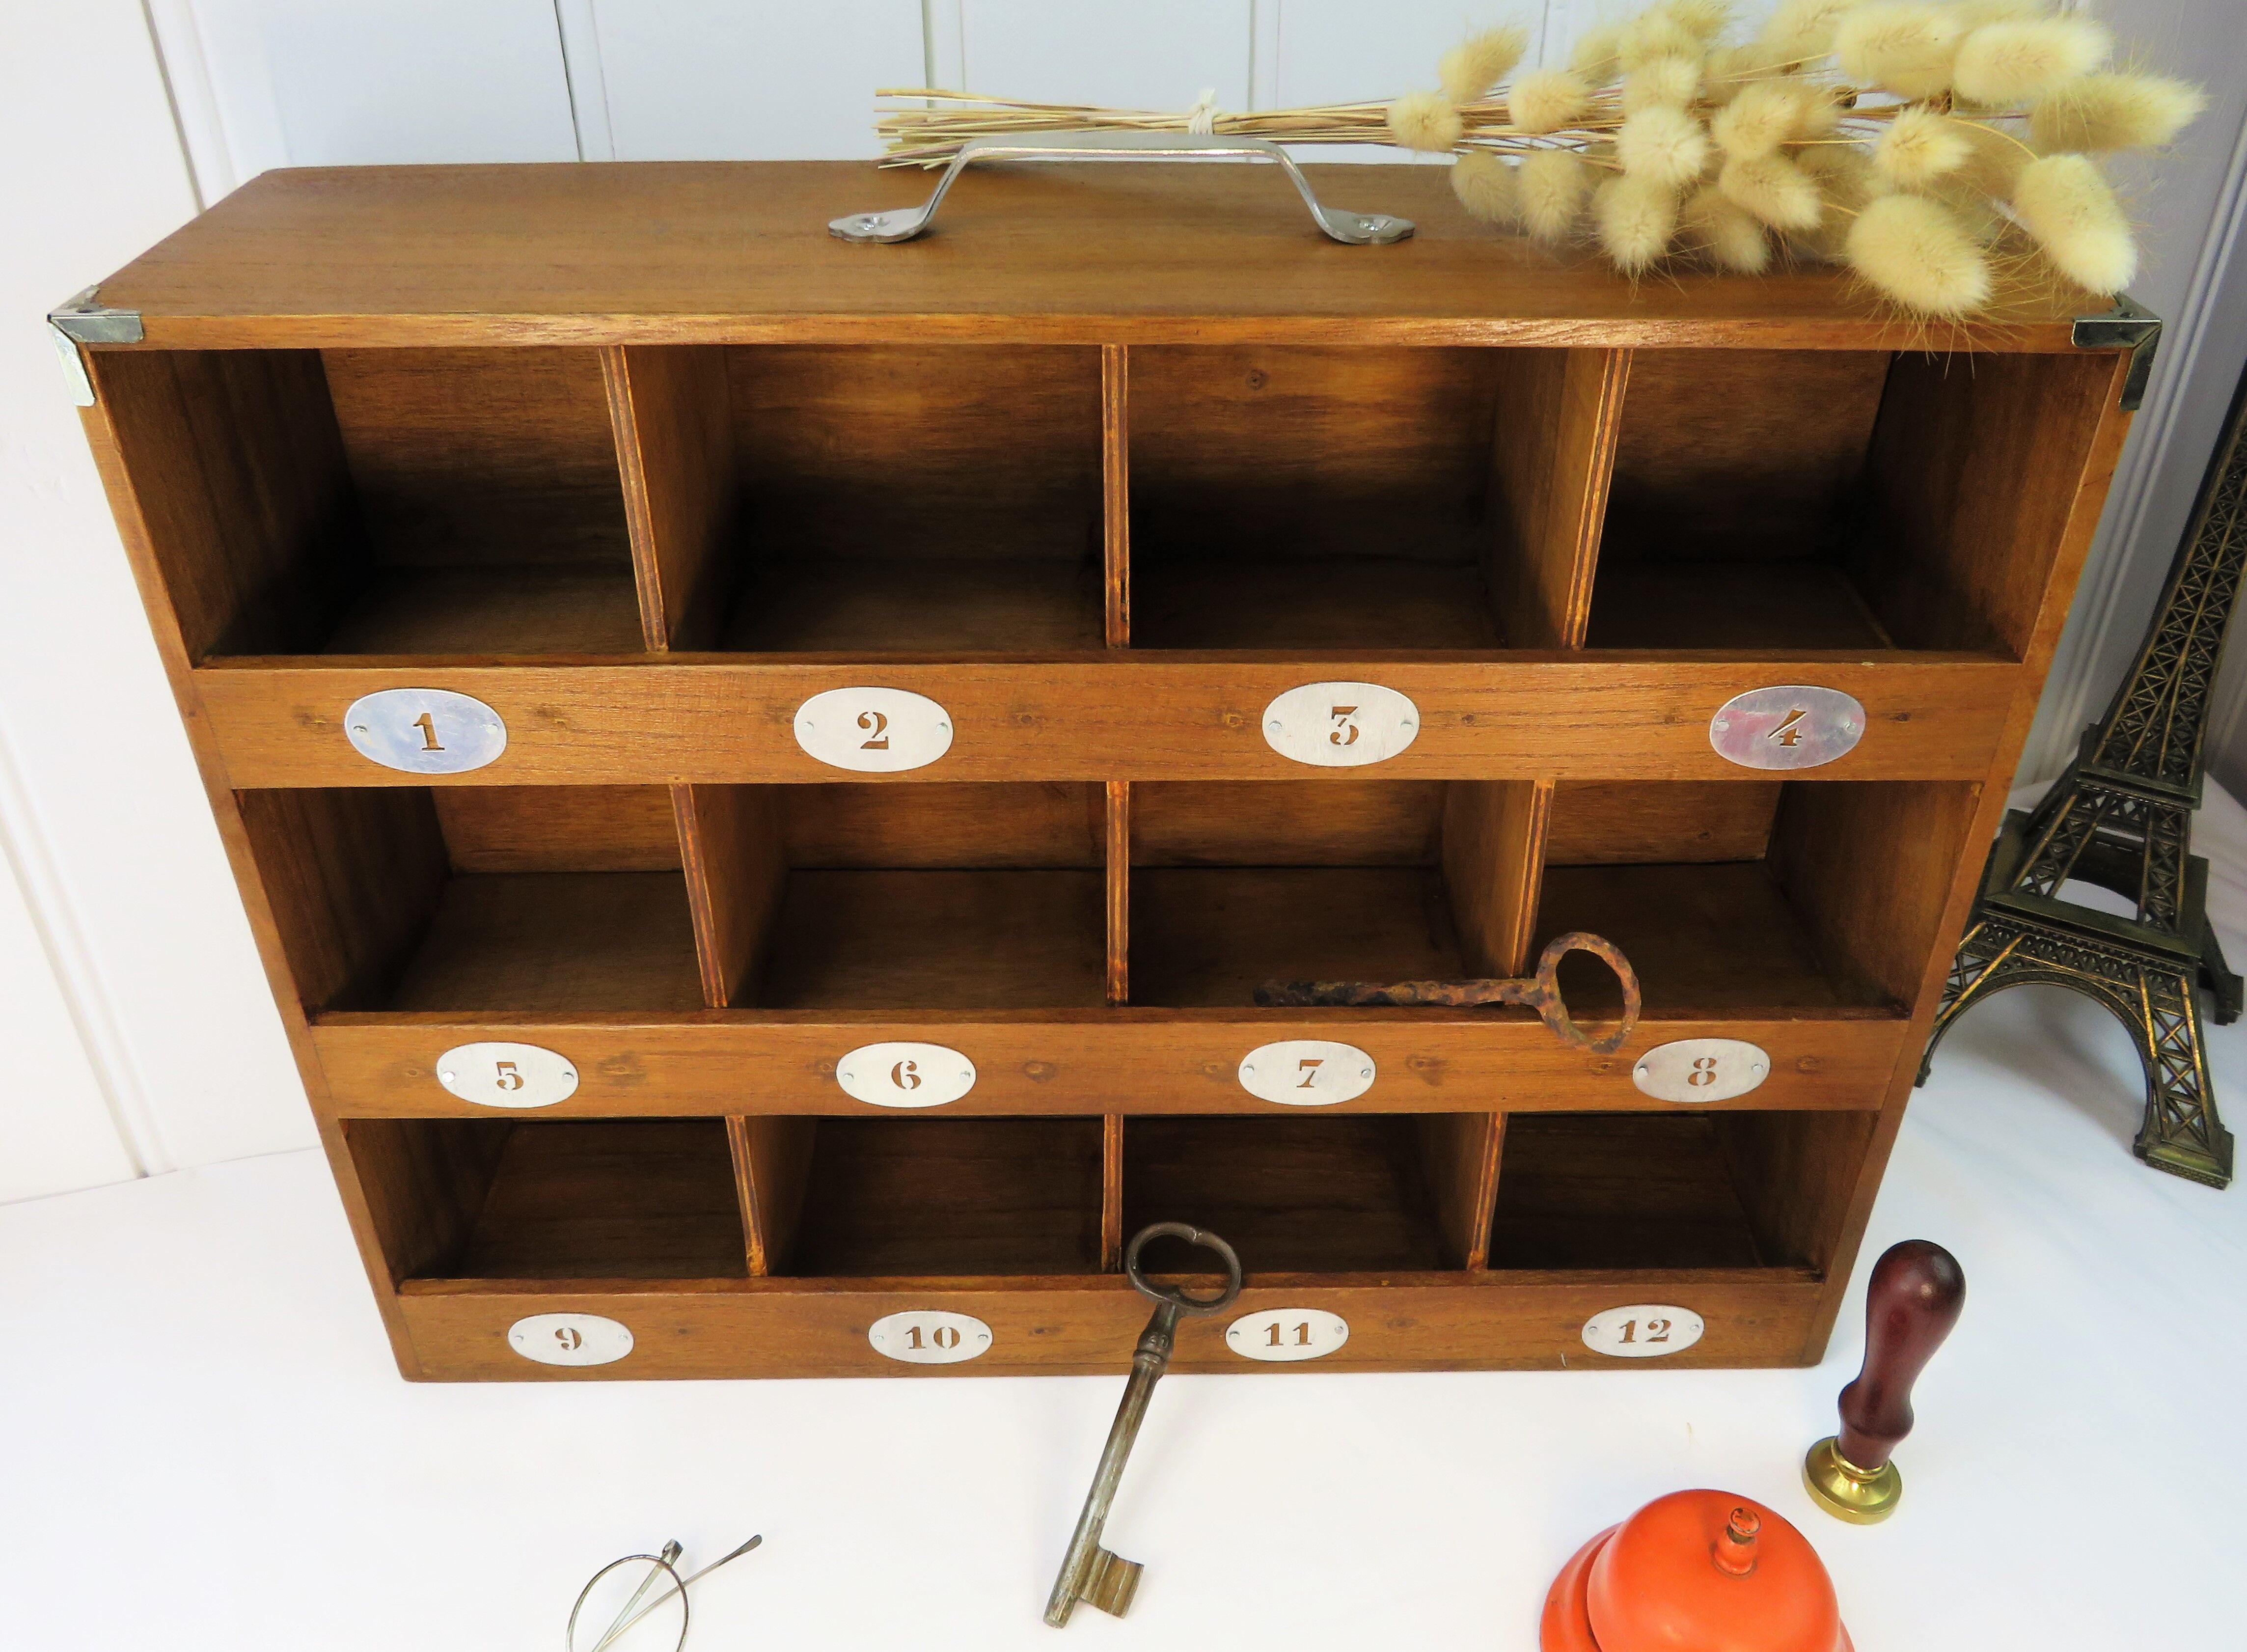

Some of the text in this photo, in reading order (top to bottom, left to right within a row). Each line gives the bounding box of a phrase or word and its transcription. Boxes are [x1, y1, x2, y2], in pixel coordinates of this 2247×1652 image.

[413, 711, 445, 751] 1
[857, 712, 889, 751] 2
[1329, 705, 1360, 746] 3
[1768, 708, 1807, 747] 4
[495, 1061, 525, 1090] 5
[891, 1061, 922, 1089] 6
[1296, 1058, 1324, 1089] 7
[1688, 1057, 1718, 1088] 8
[555, 1328, 582, 1351] 9
[905, 1326, 961, 1350] 10
[1263, 1321, 1312, 1348] 11
[1618, 1319, 1672, 1345] 12
